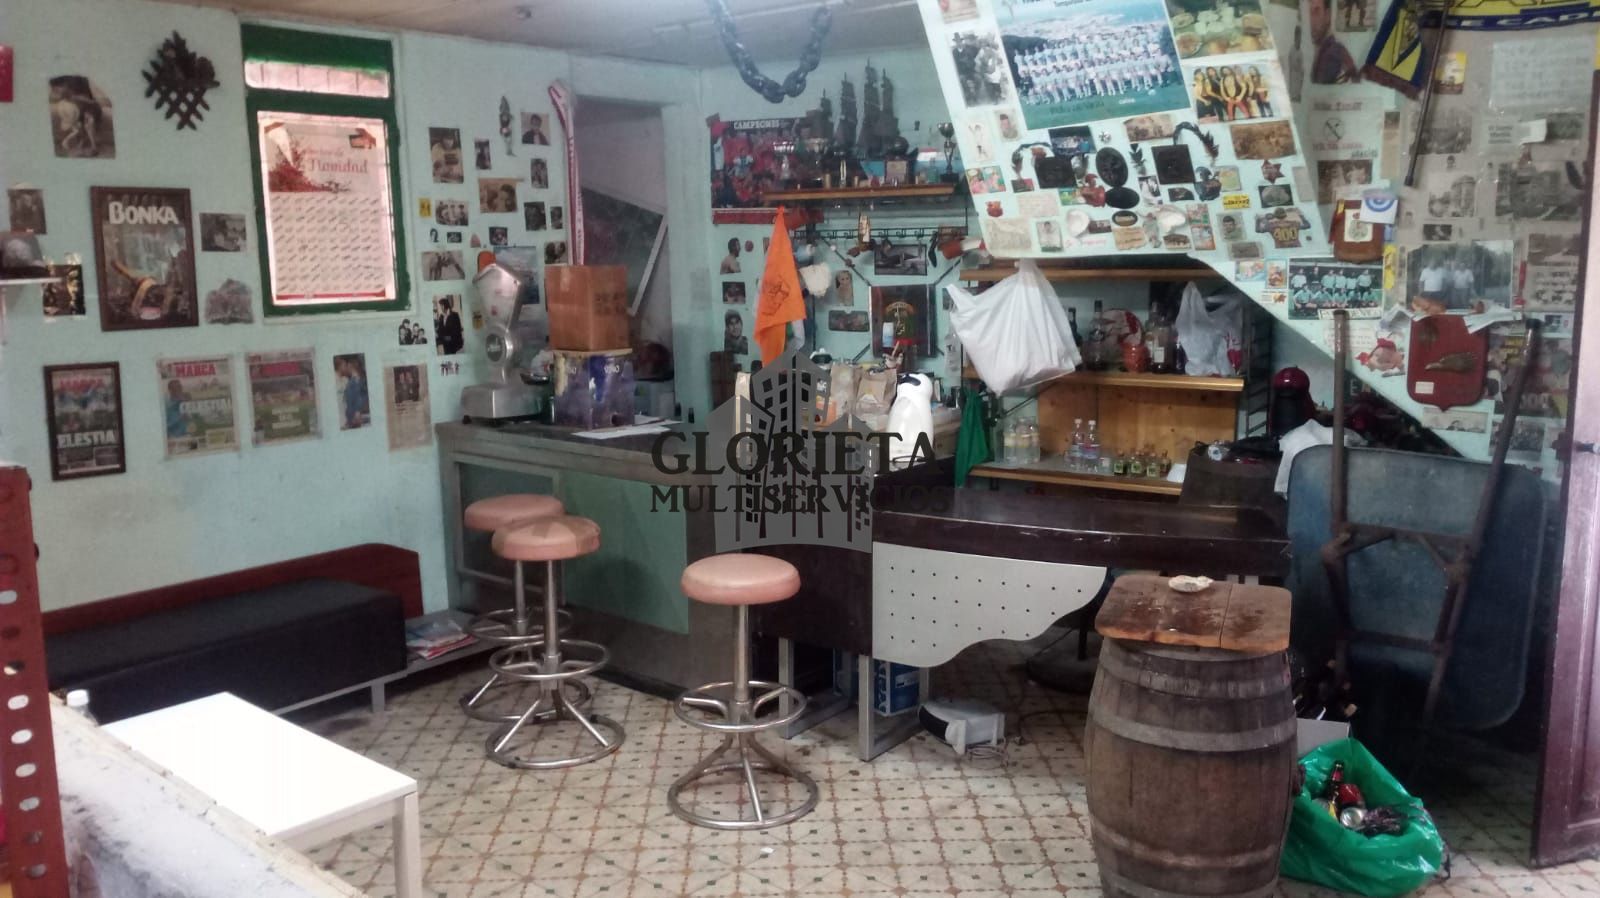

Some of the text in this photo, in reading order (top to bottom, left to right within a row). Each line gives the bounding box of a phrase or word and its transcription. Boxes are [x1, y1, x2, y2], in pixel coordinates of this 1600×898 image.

[733, 119, 780, 130] CAMPEONES
[108, 200, 180, 225] BONKA
[175, 362, 217, 378] MARCA
